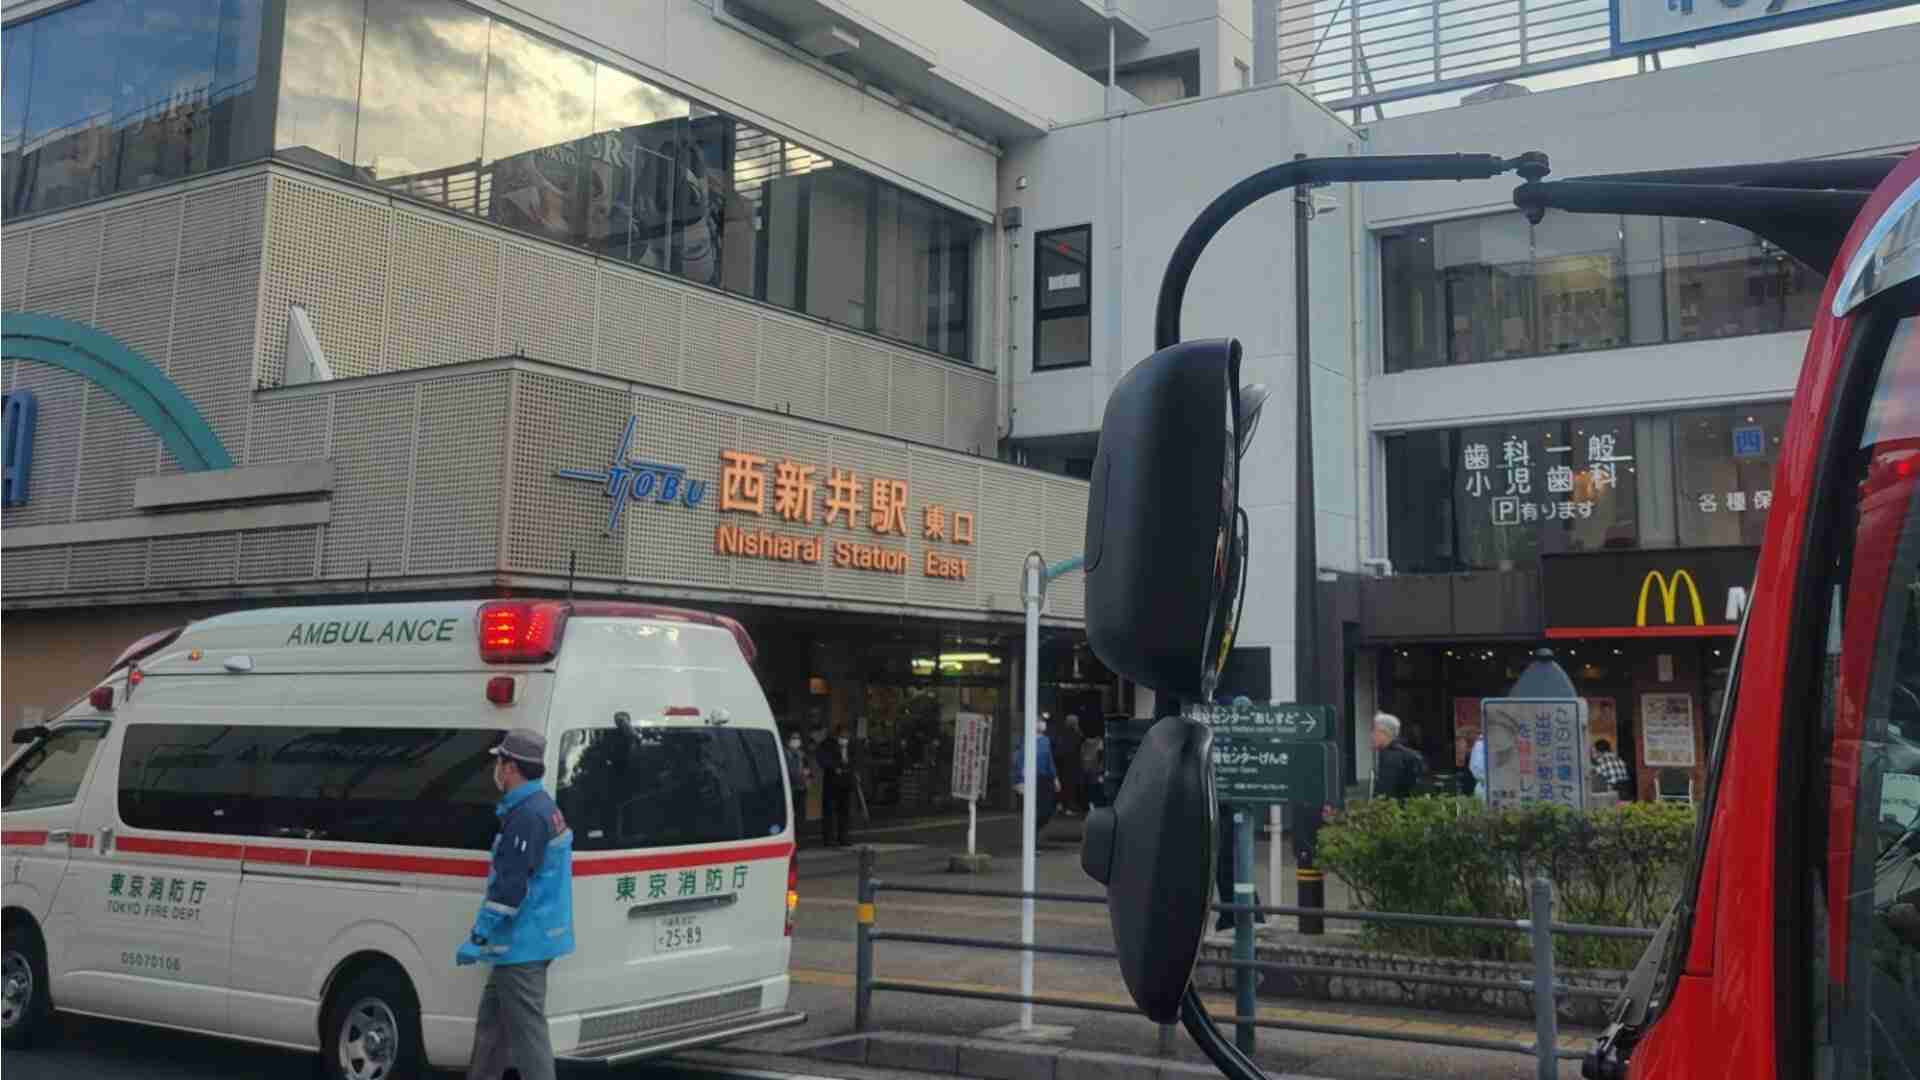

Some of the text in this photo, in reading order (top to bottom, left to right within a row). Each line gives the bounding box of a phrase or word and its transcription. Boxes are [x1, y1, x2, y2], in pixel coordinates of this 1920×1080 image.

[607, 466, 708, 509] TOBU
[1465, 463, 1617, 496] 小児歯科
[720, 449, 974, 546] 西新井駅 東口
[716, 523, 969, 580] Nishiarai Station East
[285, 618, 459, 646] AMBULANCE
[108, 872, 208, 905] 東京消防庁
[615, 865, 749, 902] 東京消防庁
[106, 899, 142, 916] TOKYO
[144, 903, 169, 920] FIRE
